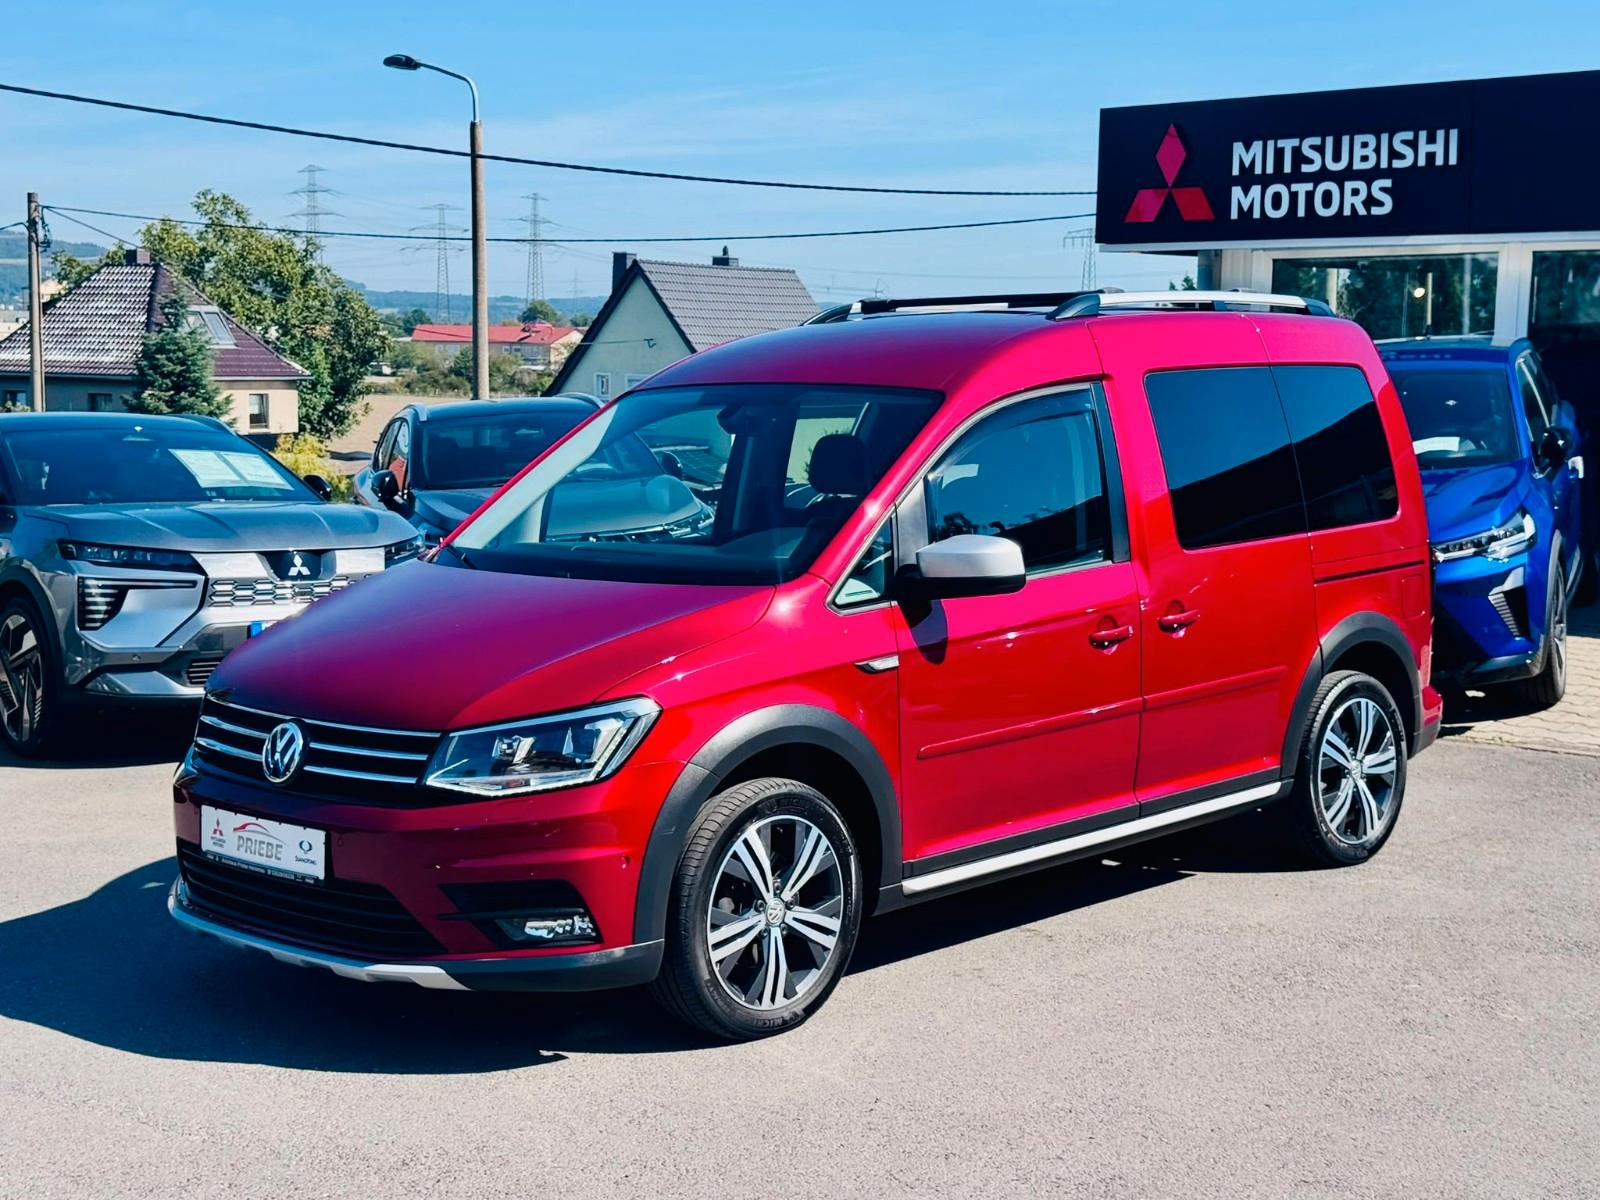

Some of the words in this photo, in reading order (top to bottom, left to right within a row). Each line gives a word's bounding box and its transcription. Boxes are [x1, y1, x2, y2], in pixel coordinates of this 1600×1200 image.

[1232, 128, 1458, 176] MITSUBISHI
[1230, 178, 1393, 220] MOTORS
[236, 834, 284, 861] PRIEBE
